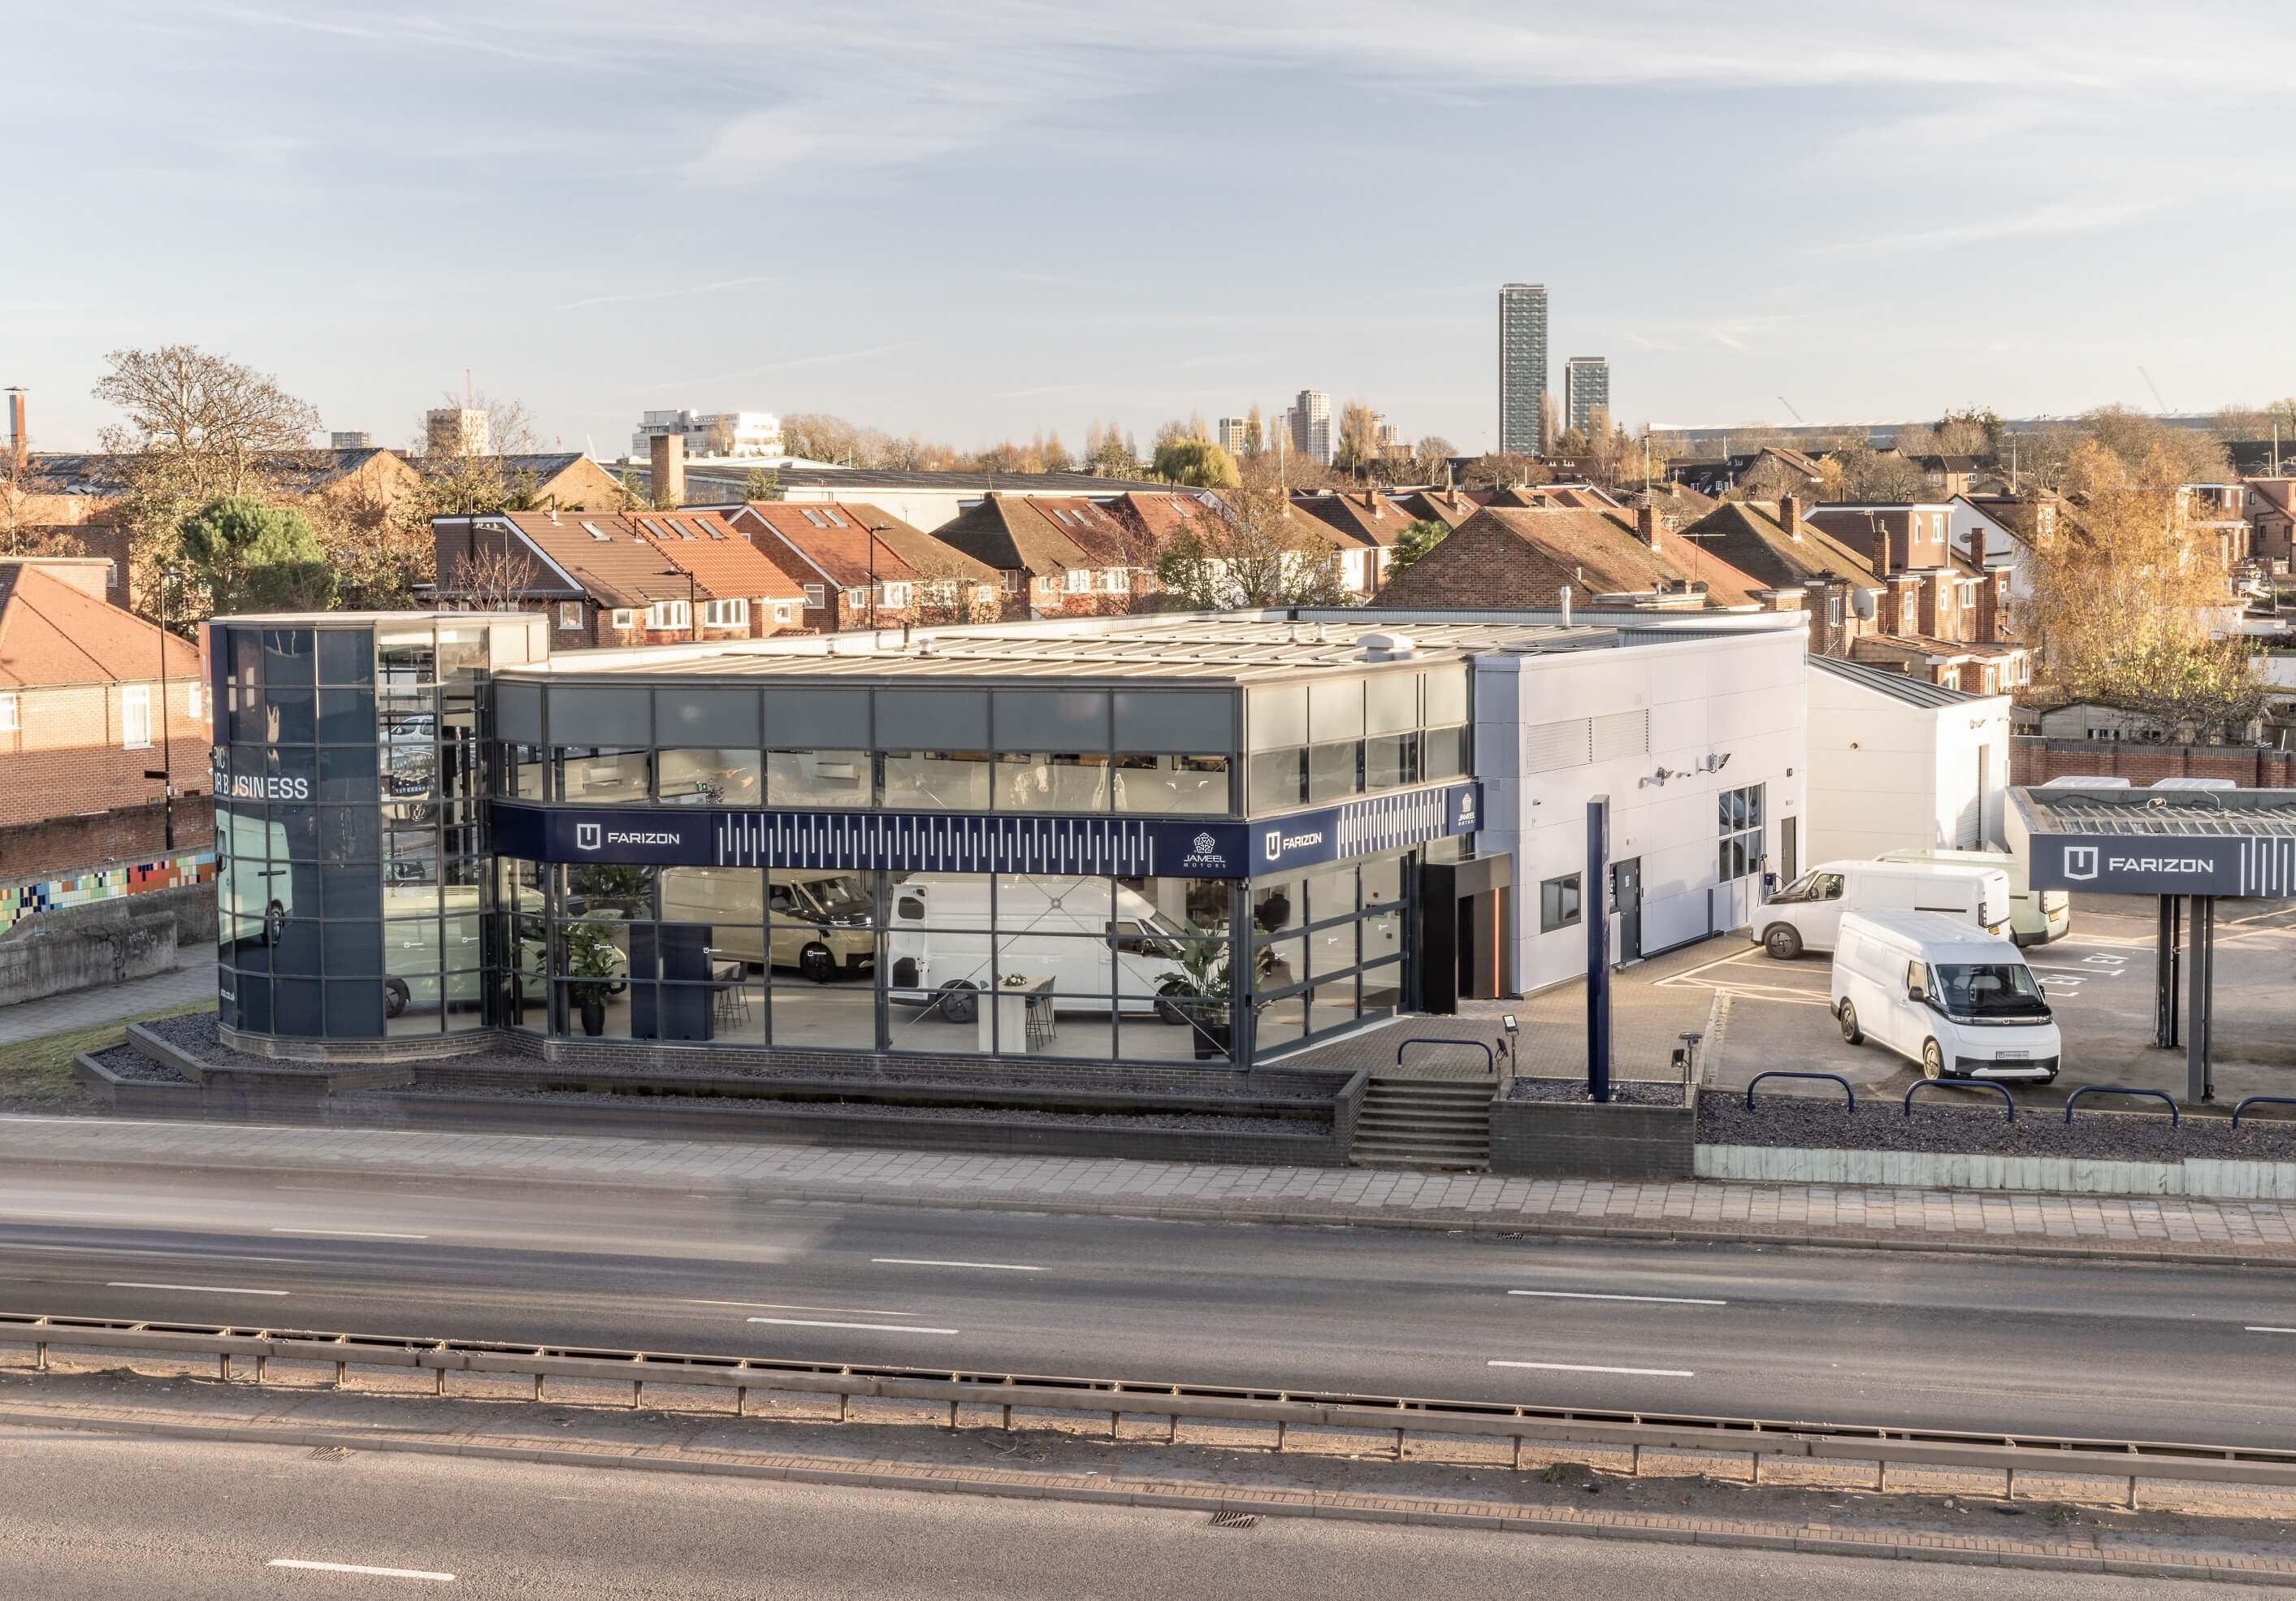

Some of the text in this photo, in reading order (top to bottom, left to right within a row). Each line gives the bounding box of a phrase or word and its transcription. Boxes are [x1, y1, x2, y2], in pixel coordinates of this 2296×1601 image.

[223, 773, 309, 799] BUSINESS
[608, 832, 680, 844] FARIZON
[1283, 831, 1322, 850] FARIZON
[2109, 857, 2213, 873] FARIZON
